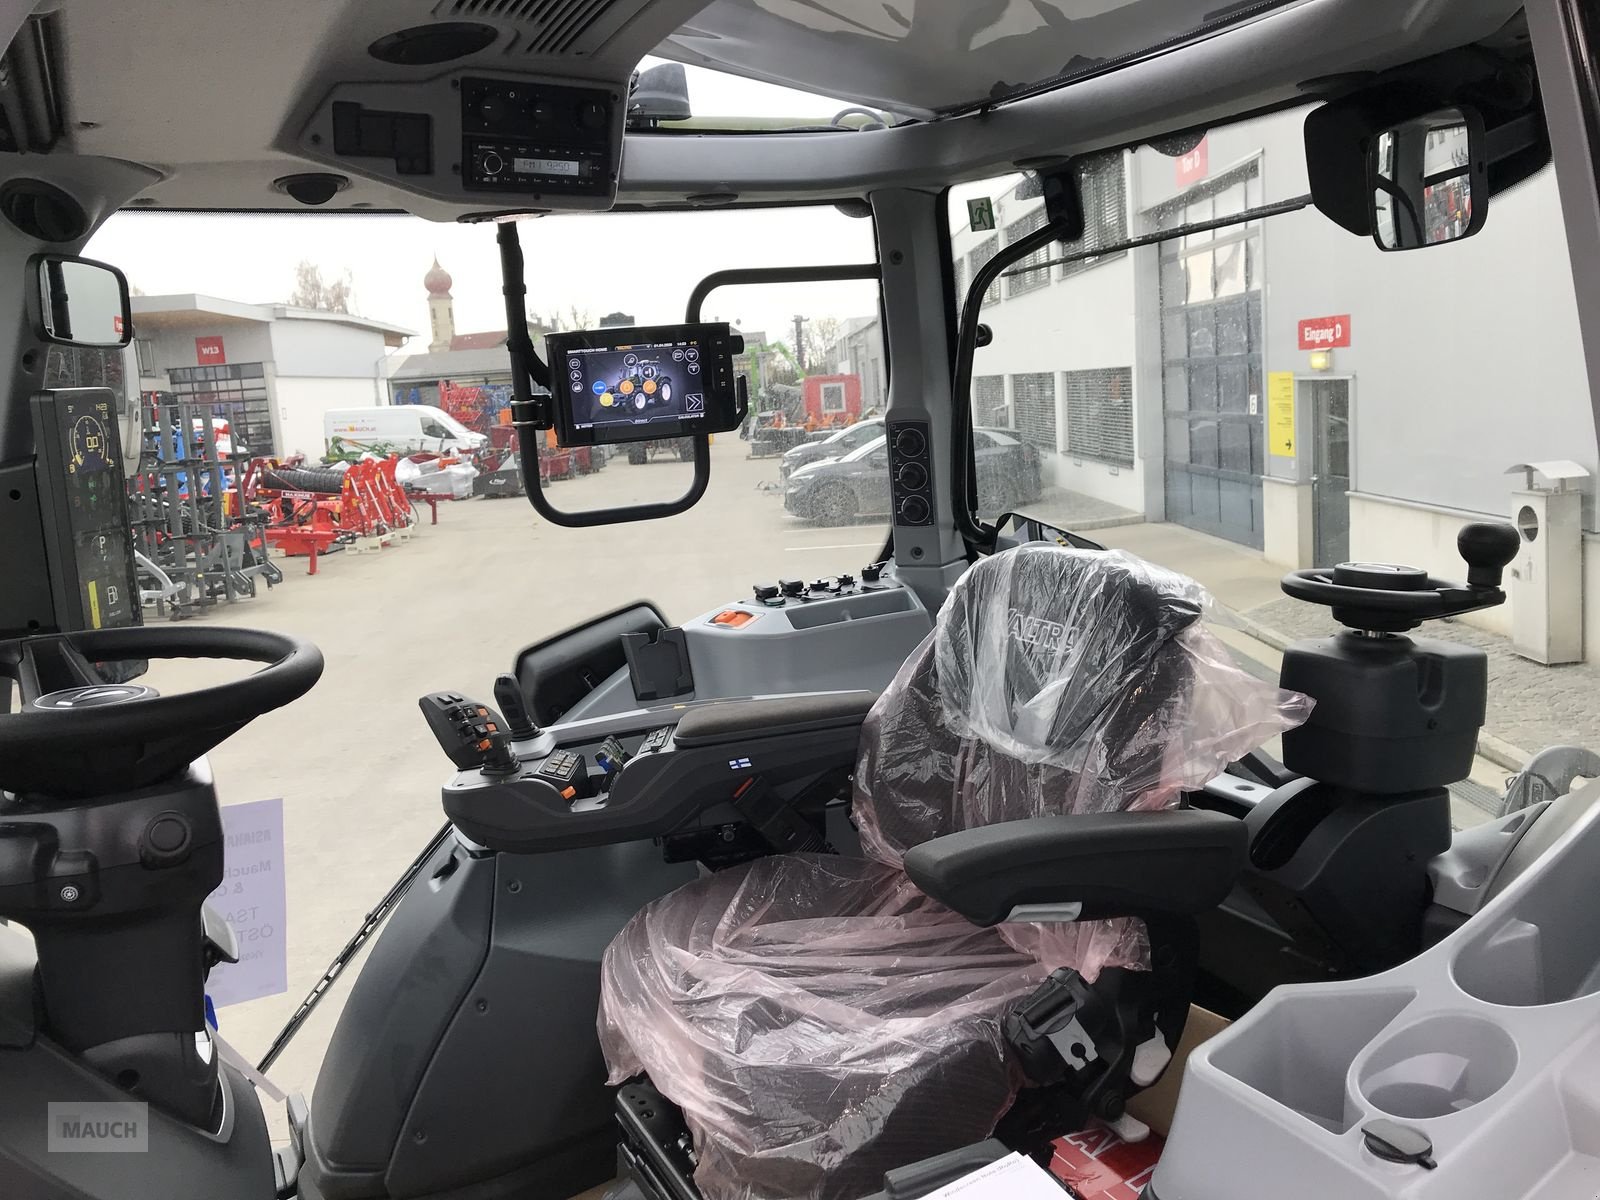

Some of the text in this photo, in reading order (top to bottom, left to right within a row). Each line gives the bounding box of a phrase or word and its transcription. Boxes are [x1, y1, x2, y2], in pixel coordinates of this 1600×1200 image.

[1194, 150, 1201, 168] D
[1304, 323, 1342, 344] Eingang D
[201, 346, 220, 355] W13
